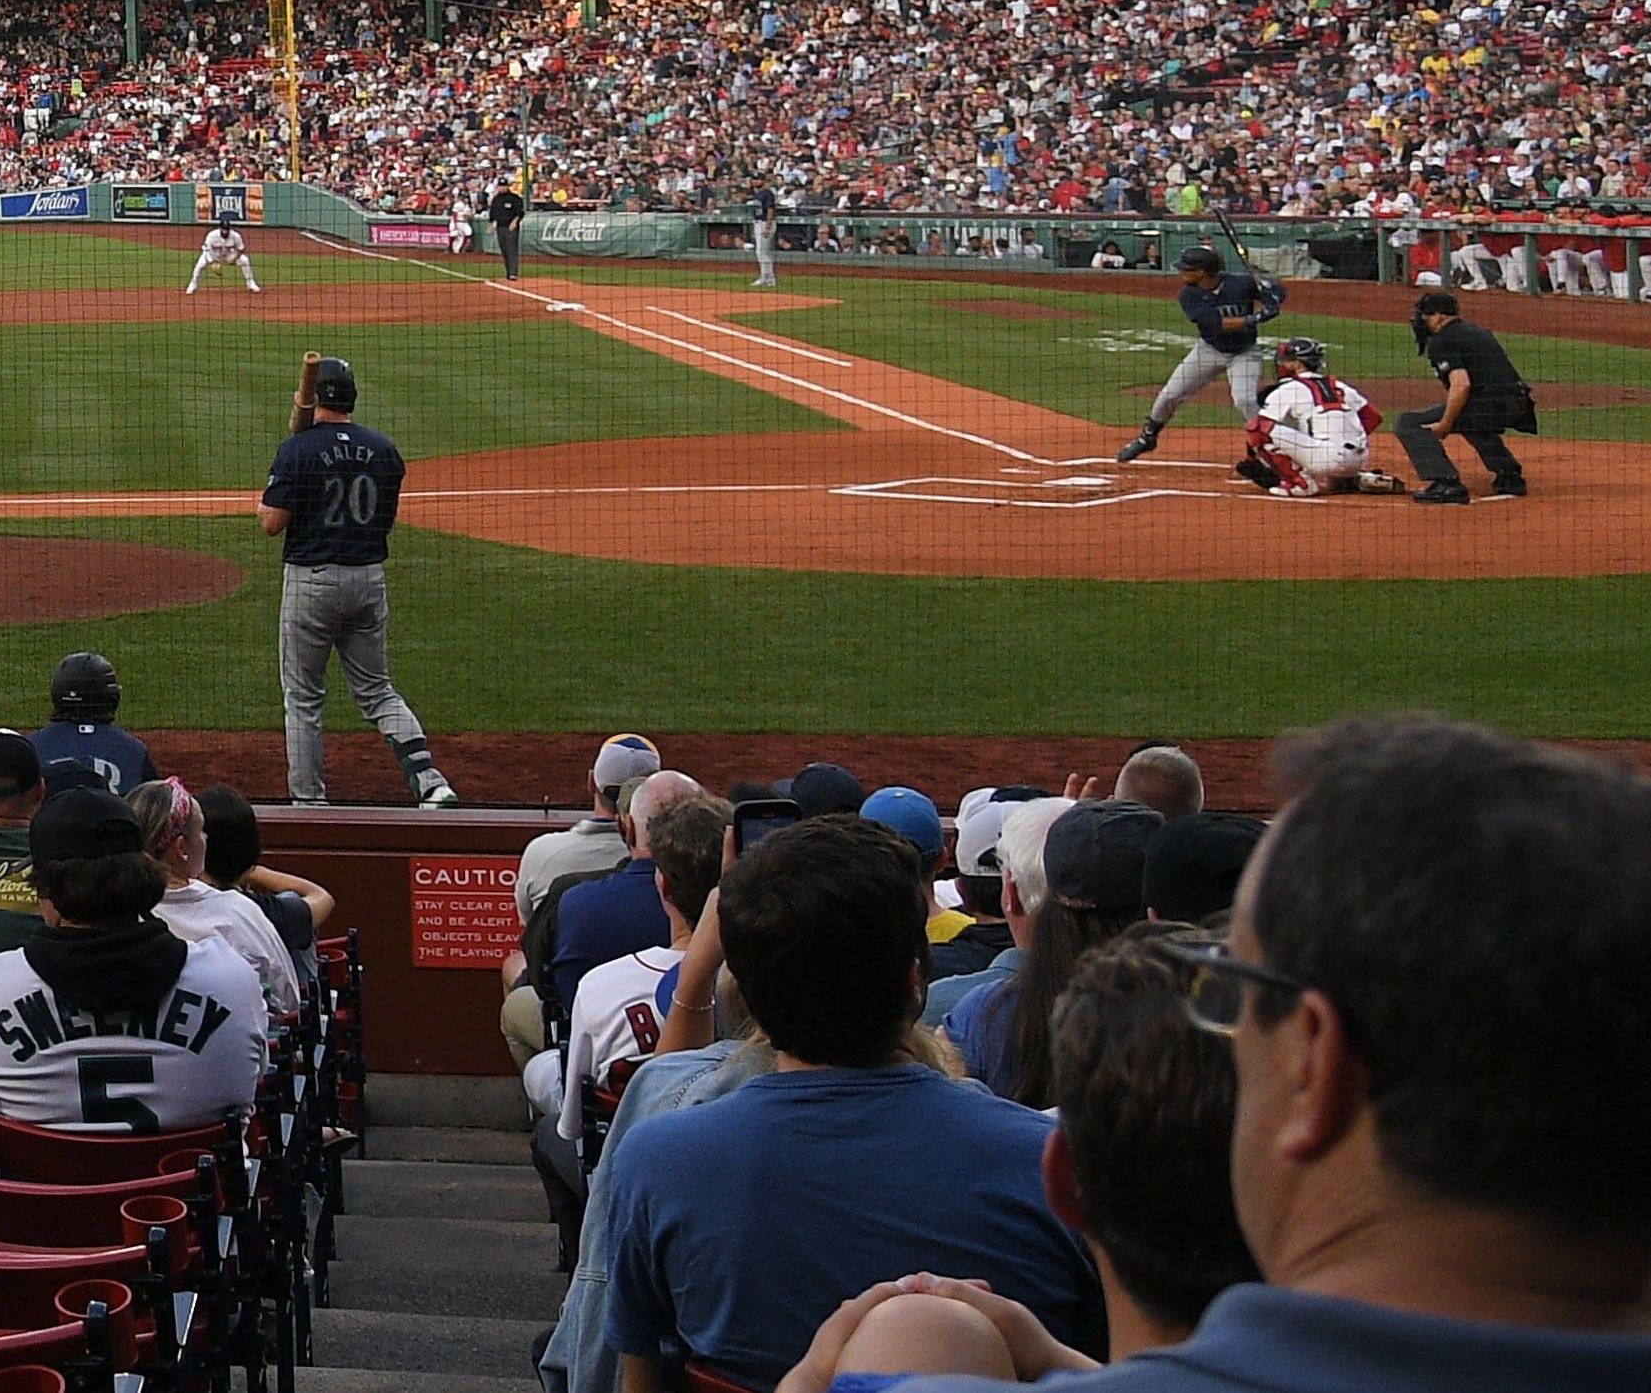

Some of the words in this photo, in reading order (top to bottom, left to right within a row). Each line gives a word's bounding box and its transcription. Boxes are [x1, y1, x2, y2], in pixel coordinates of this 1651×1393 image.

[319, 444, 376, 468] RALEY
[322, 473, 378, 527] 20
[414, 867, 518, 887] CAUTIO
[414, 900, 444, 911] STAY
[449, 901, 493, 911] CLEAR
[417, 916, 443, 927] AND
[448, 916, 466, 927] BE
[471, 916, 513, 927] ALERT
[421, 932, 483, 943] OBJECTS
[487, 932, 520, 943] LEAV
[418, 946, 444, 958] THE
[449, 947, 505, 959] PLAYING
[77, 1054, 161, 1134] 5
